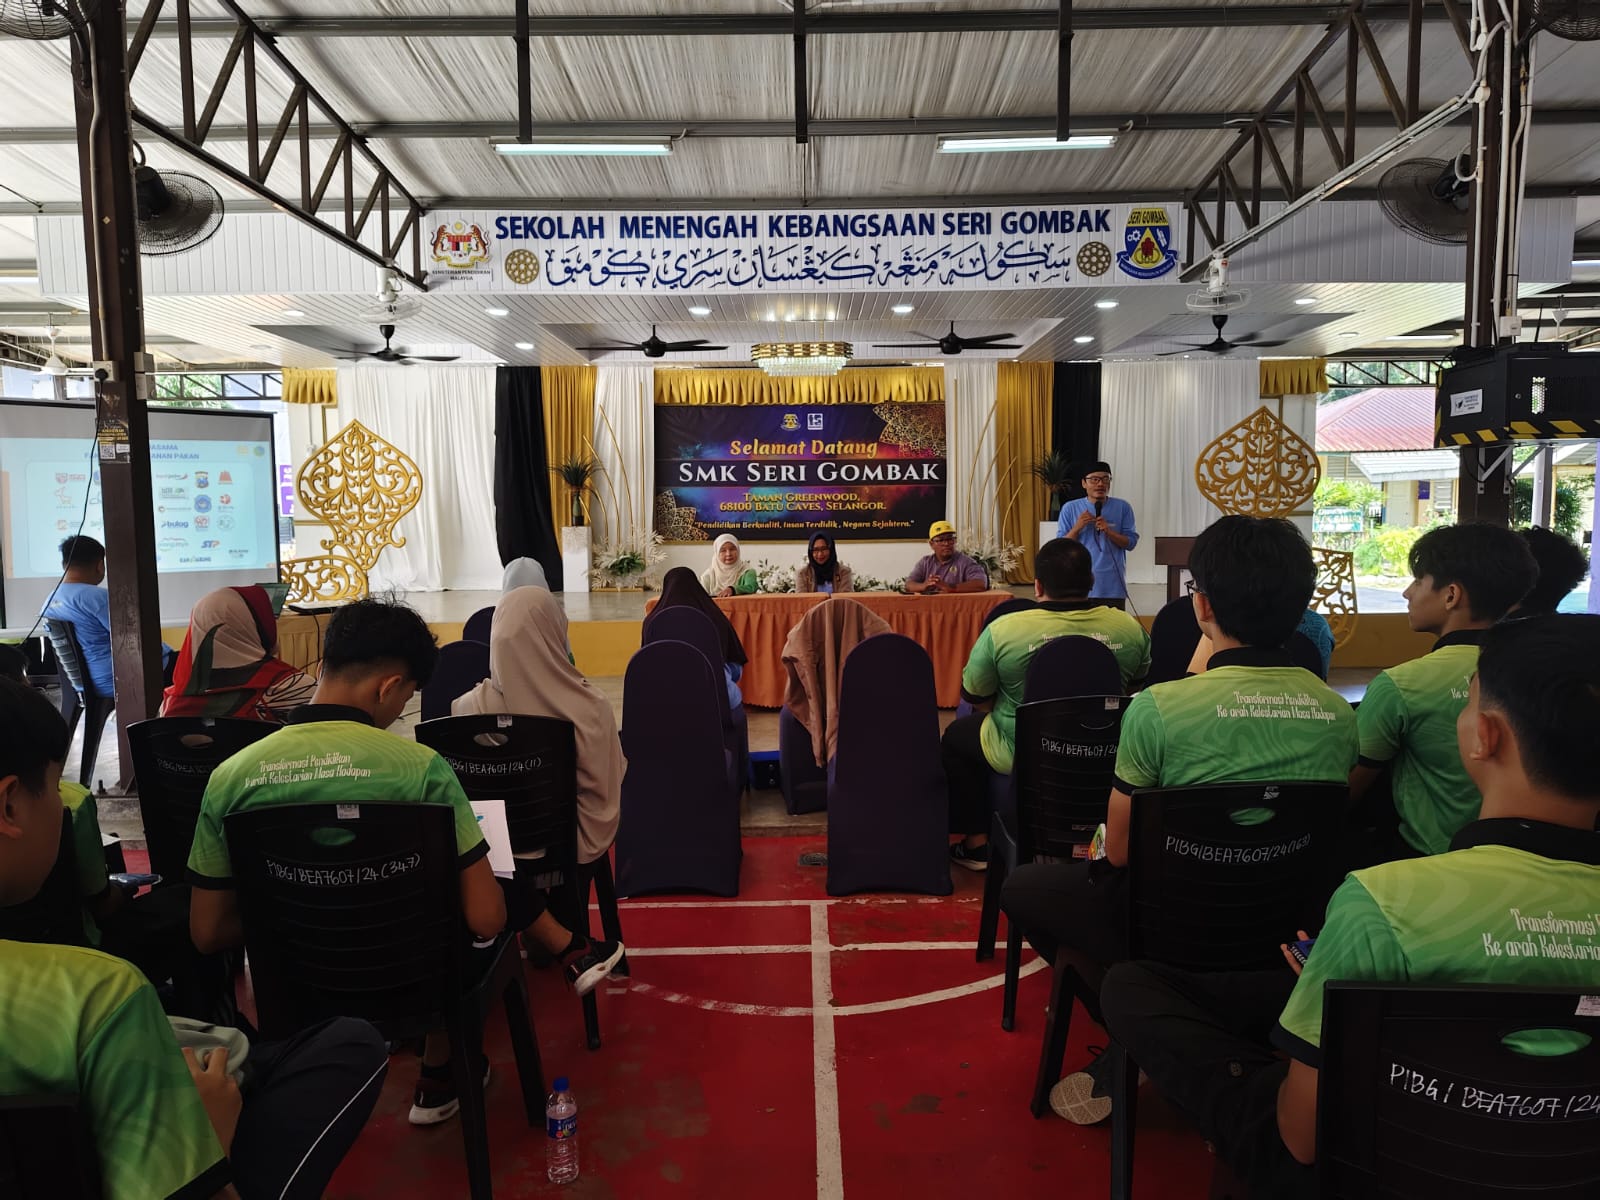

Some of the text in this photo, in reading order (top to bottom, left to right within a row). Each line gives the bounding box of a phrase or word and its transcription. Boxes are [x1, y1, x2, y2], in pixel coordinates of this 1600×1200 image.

[495, 209, 1111, 240] SEKOLAH MENENGAH KEBANGSAAN SERI GOMBAK
[151, 443, 178, 451] ASAMA
[730, 438, 878, 459] Selamat Datang
[151, 453, 173, 461] ANAN
[679, 462, 940, 482] SMK SERI GOMBAK
[744, 492, 861, 502] TAMAN GREENWOOD,
[720, 501, 887, 512] 68100 BATU CAVES, SELANGOR.
[843, 521, 871, 530] Negara
[201, 540, 220, 548] STP
[1233, 690, 1320, 706] Transformasi Pendidikan
[1216, 704, 1228, 718] Ke
[1230, 705, 1249, 718] arah
[1249, 704, 1291, 719] Kelestarian
[260, 752, 351, 773] Transformasi Pendidikan
[269, 768, 313, 785] Kelestarian
[1510, 908, 1596, 936] Transformasi
[1482, 932, 1502, 957] Ke
[1505, 933, 1538, 957] arah
